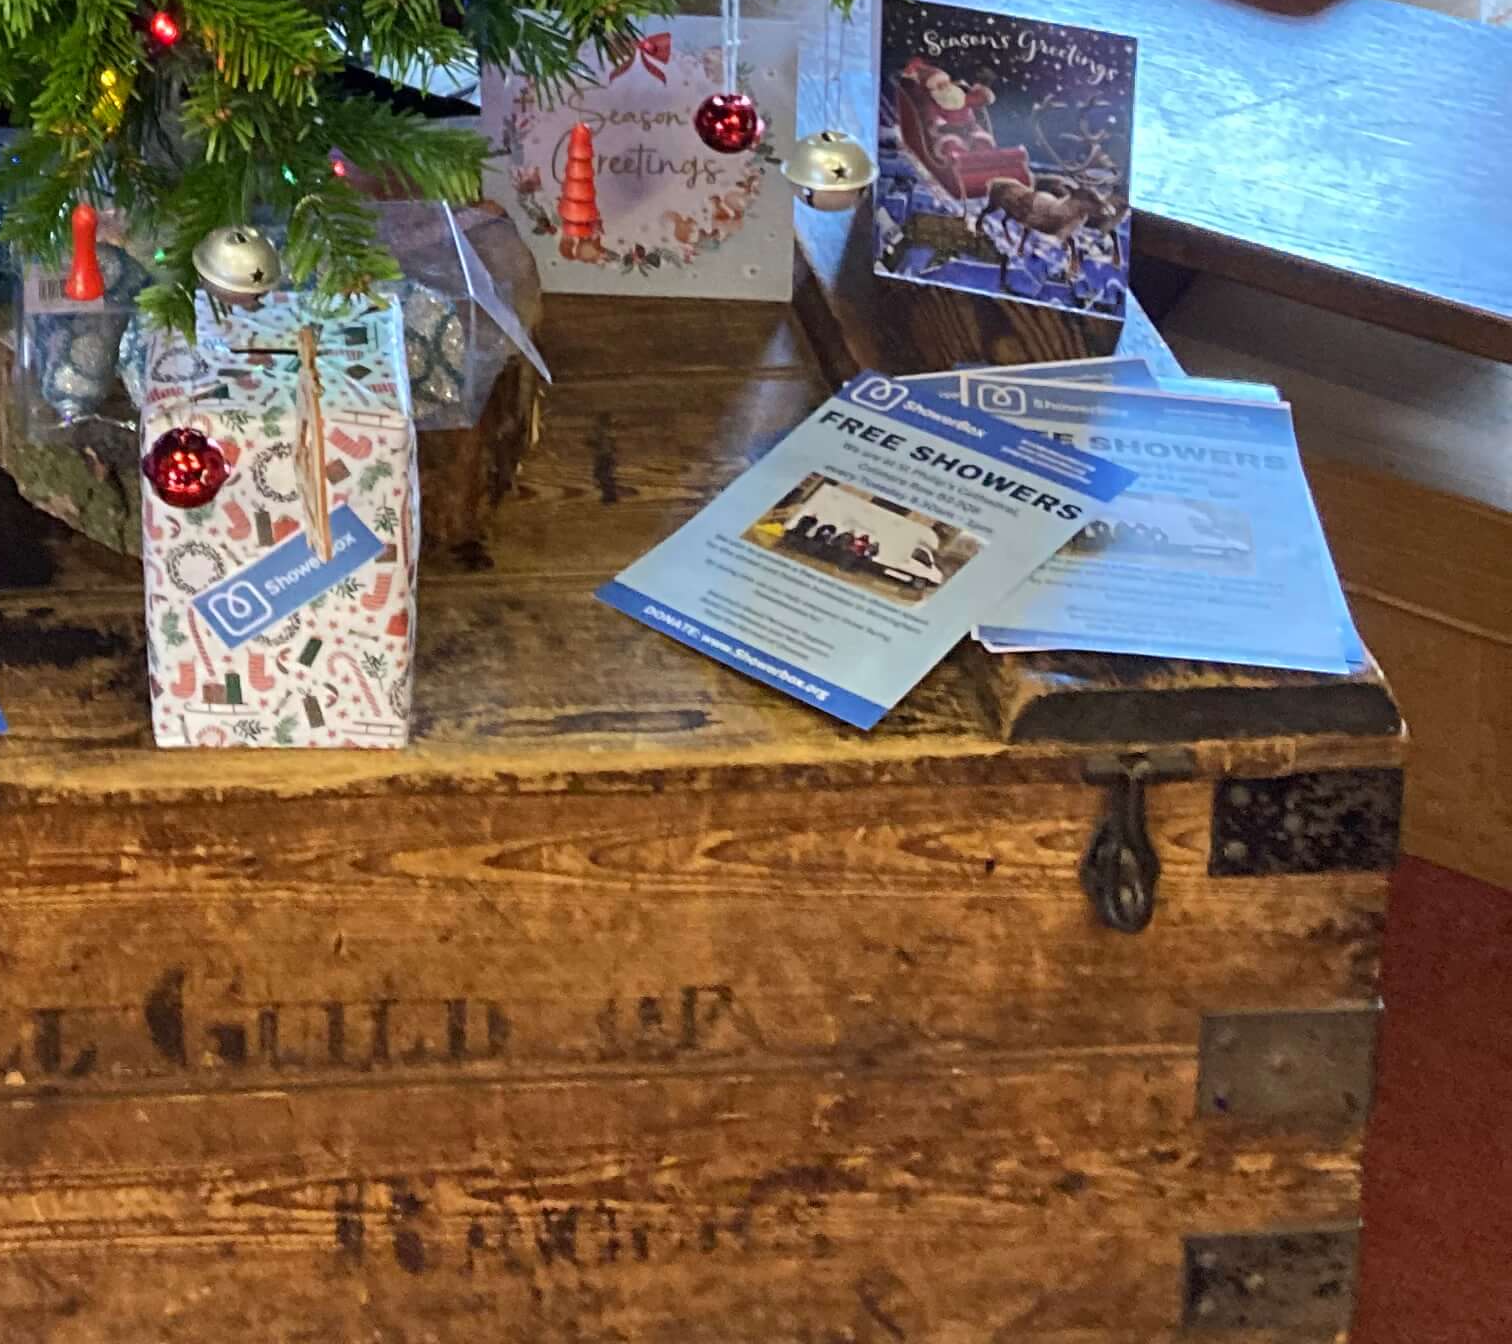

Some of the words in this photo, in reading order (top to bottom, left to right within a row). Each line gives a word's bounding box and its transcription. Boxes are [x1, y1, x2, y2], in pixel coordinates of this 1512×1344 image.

[923, 29, 1011, 56] Season's
[1017, 29, 1119, 86] Greetings
[567, 84, 691, 136] Season'
[819, 410, 906, 452] FREE
[909, 444, 1084, 522] SHOWERS
[1088, 436, 1288, 471] SHOWERS
[264, 531, 357, 597] Showeox
